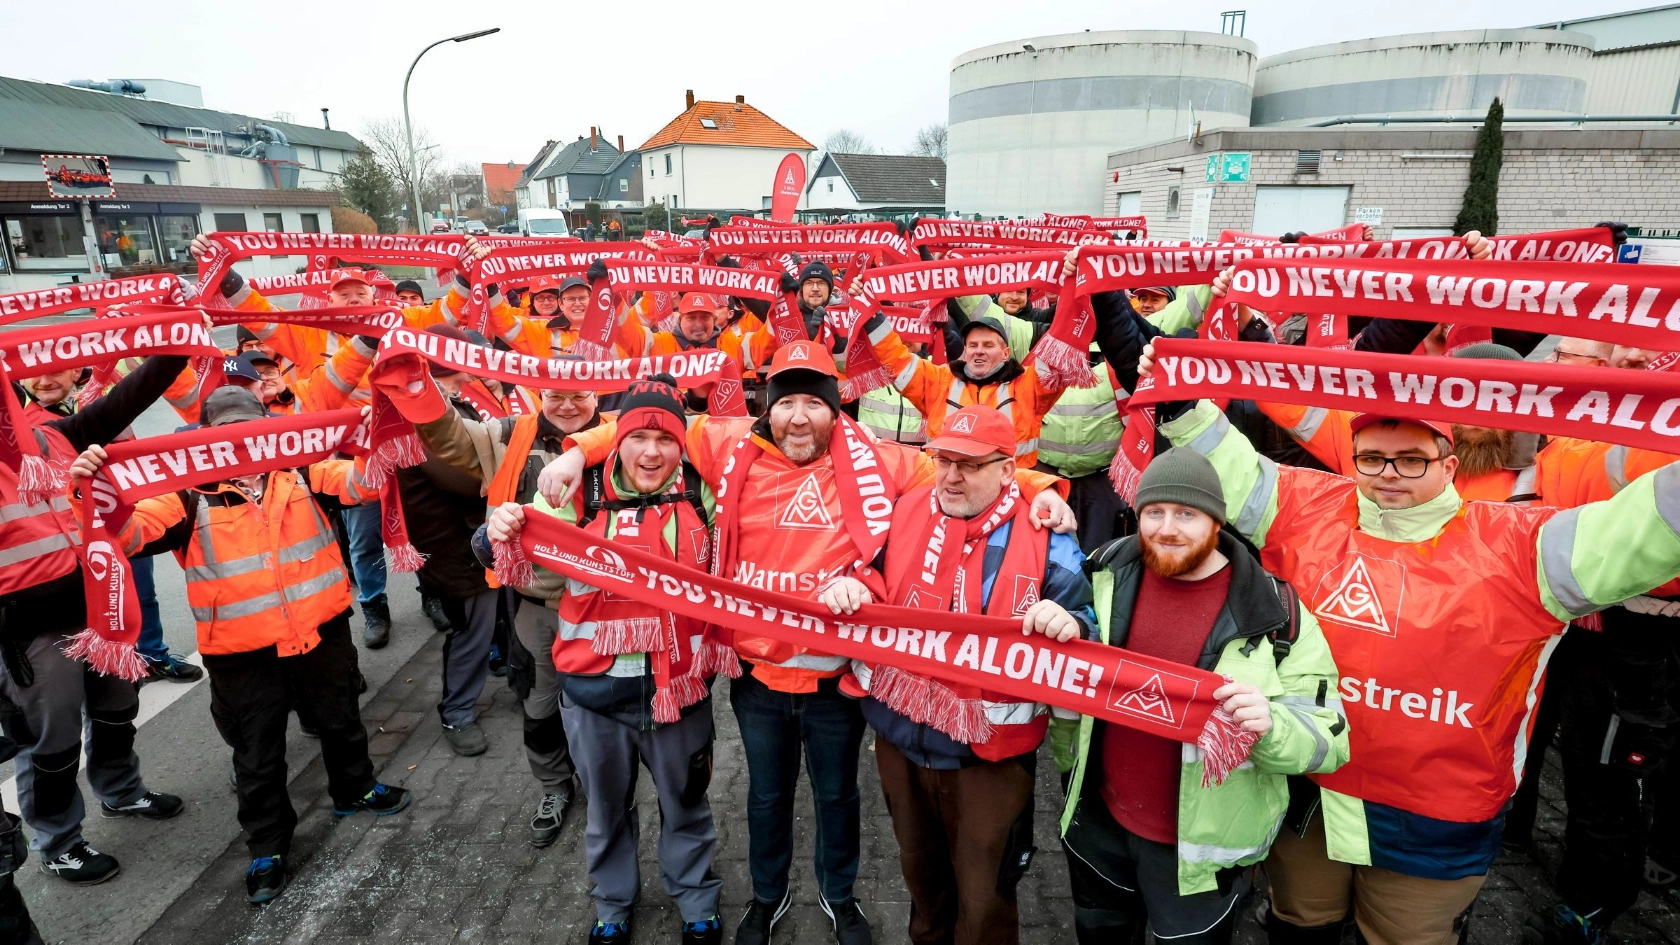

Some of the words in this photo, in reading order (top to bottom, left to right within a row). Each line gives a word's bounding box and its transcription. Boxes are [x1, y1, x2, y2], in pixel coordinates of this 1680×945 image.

[224, 233, 278, 251] YOU
[283, 233, 355, 250] NEVER
[360, 234, 422, 252] WORK
[710, 231, 744, 247] YOU
[747, 229, 802, 245] NEVER
[807, 229, 860, 244] WORK
[939, 223, 995, 238] NEVER
[999, 225, 1056, 243] WORK
[481, 256, 506, 279] OU
[507, 252, 567, 272] NEVER
[800, 254, 833, 264] EVER
[1087, 253, 1148, 279] YOU
[1152, 248, 1254, 274] NEVER
[77, 278, 155, 301] WORK
[255, 272, 308, 290] WORK
[607, 266, 630, 286] OU
[633, 266, 694, 284] NEVER
[698, 268, 755, 290] WORK
[888, 266, 960, 294] NEVER
[963, 261, 1033, 288] WORK
[1231, 269, 1281, 298] OU
[1285, 267, 1414, 303] NEVER
[1426, 274, 1590, 318] WORK
[17, 327, 129, 368] WORK
[380, 329, 438, 358] YOU
[444, 338, 540, 378] NEVER
[547, 358, 632, 380] WORK
[635, 351, 728, 380] ALONE!
[1156, 356, 1232, 387] YOU
[1234, 359, 1383, 400] NEVER
[1388, 371, 1564, 418] WORK
[109, 440, 240, 491] NEVER
[243, 424, 348, 463] WORK
[856, 473, 893, 536] YOU
[534, 543, 558, 557] HOLZ
[558, 551, 579, 563] UND
[579, 556, 636, 581] KUNSTSTOFF
[109, 592, 118, 610] UND
[109, 608, 118, 631] HOLZ
[637, 566, 707, 604] YOU
[833, 621, 953, 664] WORK
[952, 636, 1105, 699] ALONE!
